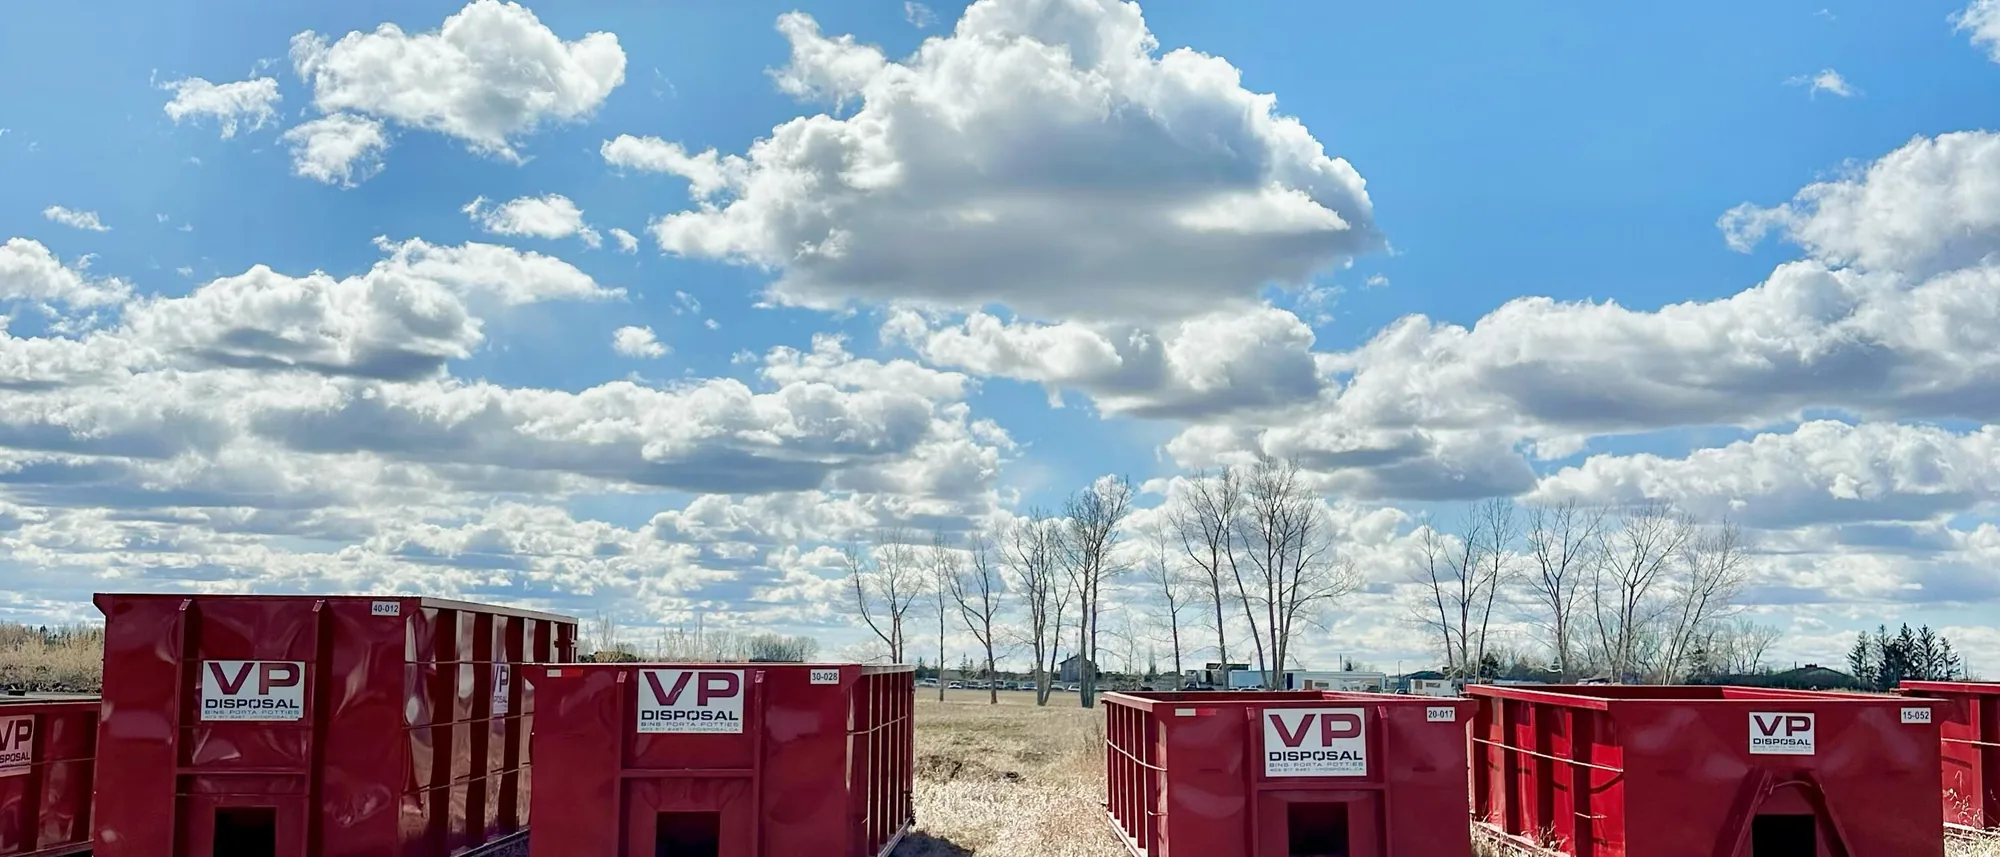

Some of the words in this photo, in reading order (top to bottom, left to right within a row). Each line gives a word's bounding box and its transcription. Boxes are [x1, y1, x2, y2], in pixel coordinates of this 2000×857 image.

[373, 604, 398, 612] 40-012
[207, 662, 300, 695] VP
[812, 672, 838, 680] 30-028
[643, 671, 739, 706] VP
[205, 699, 299, 709] DISPOSAL
[641, 710, 739, 721] DISPOSAL
[1428, 710, 1453, 718] 20-017
[1903, 711, 1929, 719] 15-052
[1268, 713, 1362, 747] VP
[1753, 715, 1811, 736] VP
[0, 752, 30, 764] SPOSAL
[1269, 751, 1363, 761] DISPOSAL
